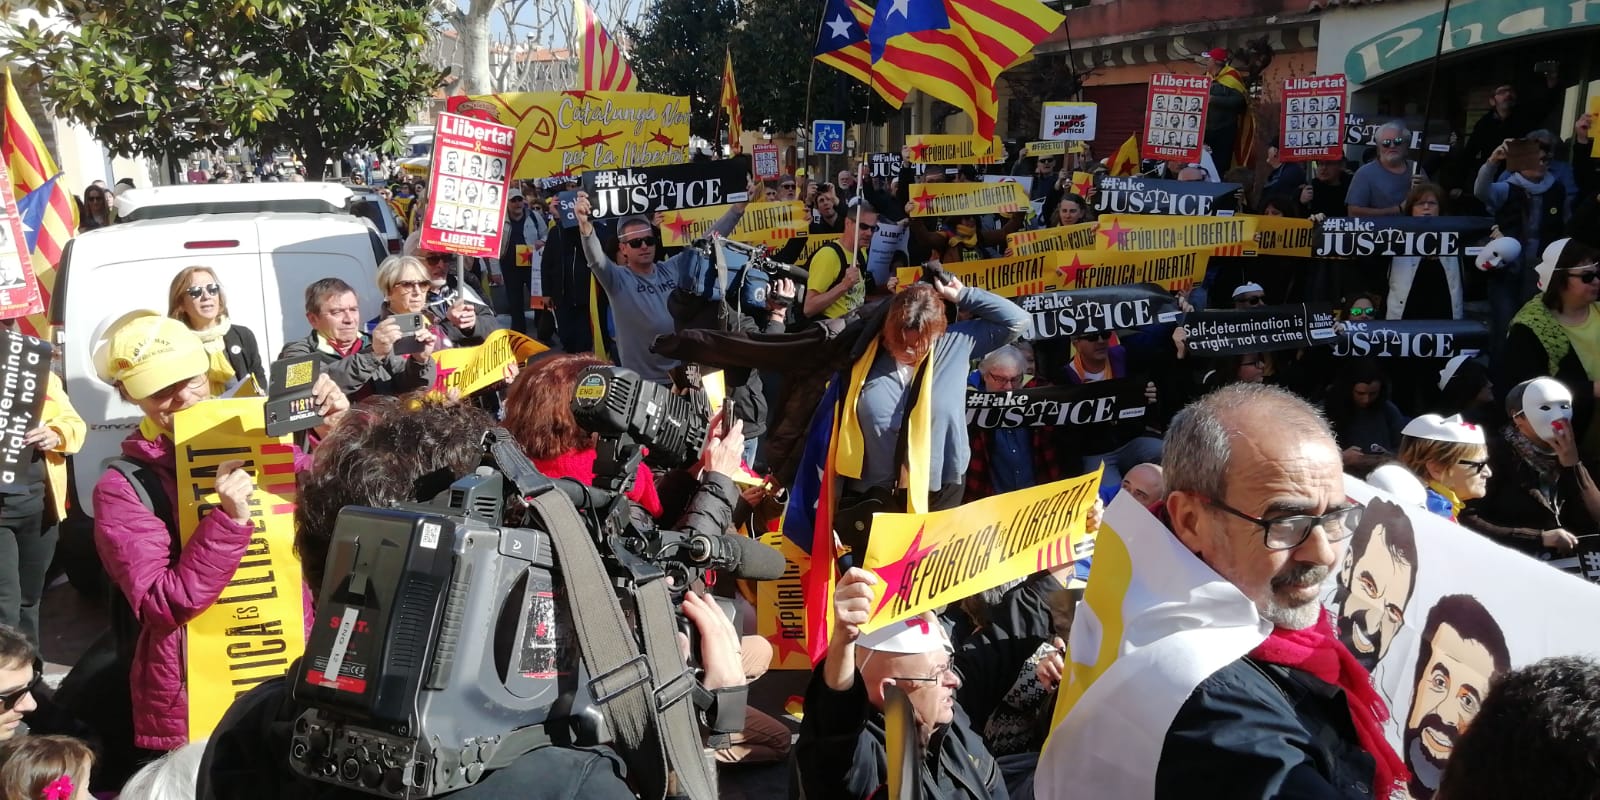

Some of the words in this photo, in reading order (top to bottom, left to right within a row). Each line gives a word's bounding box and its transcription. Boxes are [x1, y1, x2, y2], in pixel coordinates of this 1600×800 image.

[1152, 75, 1208, 89] Llibertat
[1285, 76, 1345, 90] Llibertat
[558, 98, 658, 136] Catalunya
[441, 115, 513, 146] Llibertat
[562, 149, 588, 174] per
[595, 142, 616, 168] la
[920, 144, 957, 162] REPÚBLICA
[1155, 147, 1187, 156] LIBERTÉ
[1293, 147, 1328, 155] LIBERTÉ
[594, 168, 648, 188] #Fake
[1101, 177, 1145, 191] #Fake
[592, 178, 722, 219] JUSTICE
[926, 193, 969, 215] REPÚBLICA
[973, 184, 1016, 208] LLIBERTAT
[1095, 188, 1214, 216] JUSTICE
[742, 203, 793, 237] LLIBERTAT
[1322, 218, 1374, 232] #Fake
[441, 232, 486, 248] LIBERTÉ
[1117, 224, 1176, 250] REPÚBLICA
[1184, 219, 1245, 247] LLIBERTAT
[1316, 227, 1459, 256] JUSTICE
[985, 256, 1046, 291] LLIBERTAT
[1075, 263, 1135, 289] REPÚBLICA
[1142, 253, 1197, 282] LLIBERTAT
[1023, 294, 1073, 312] #Fake
[1021, 299, 1154, 340] JUSTICE
[1183, 319, 1291, 337] Self-determination
[1294, 314, 1303, 327] is
[1313, 313, 1332, 321] Make
[1189, 341, 1198, 350] a
[1201, 334, 1234, 352] right,
[1238, 333, 1256, 345] not
[1260, 335, 1269, 344] a
[1272, 328, 1304, 342] crime
[27, 352, 40, 365] a
[22, 371, 37, 403] not
[967, 391, 1028, 408] #Fake
[5, 411, 33, 463] right,
[2, 470, 15, 484] a
[891, 522, 1001, 619] REPÚBLICA
[1000, 478, 1098, 563] LLIBERTAT
[233, 605, 259, 620] ÉS
